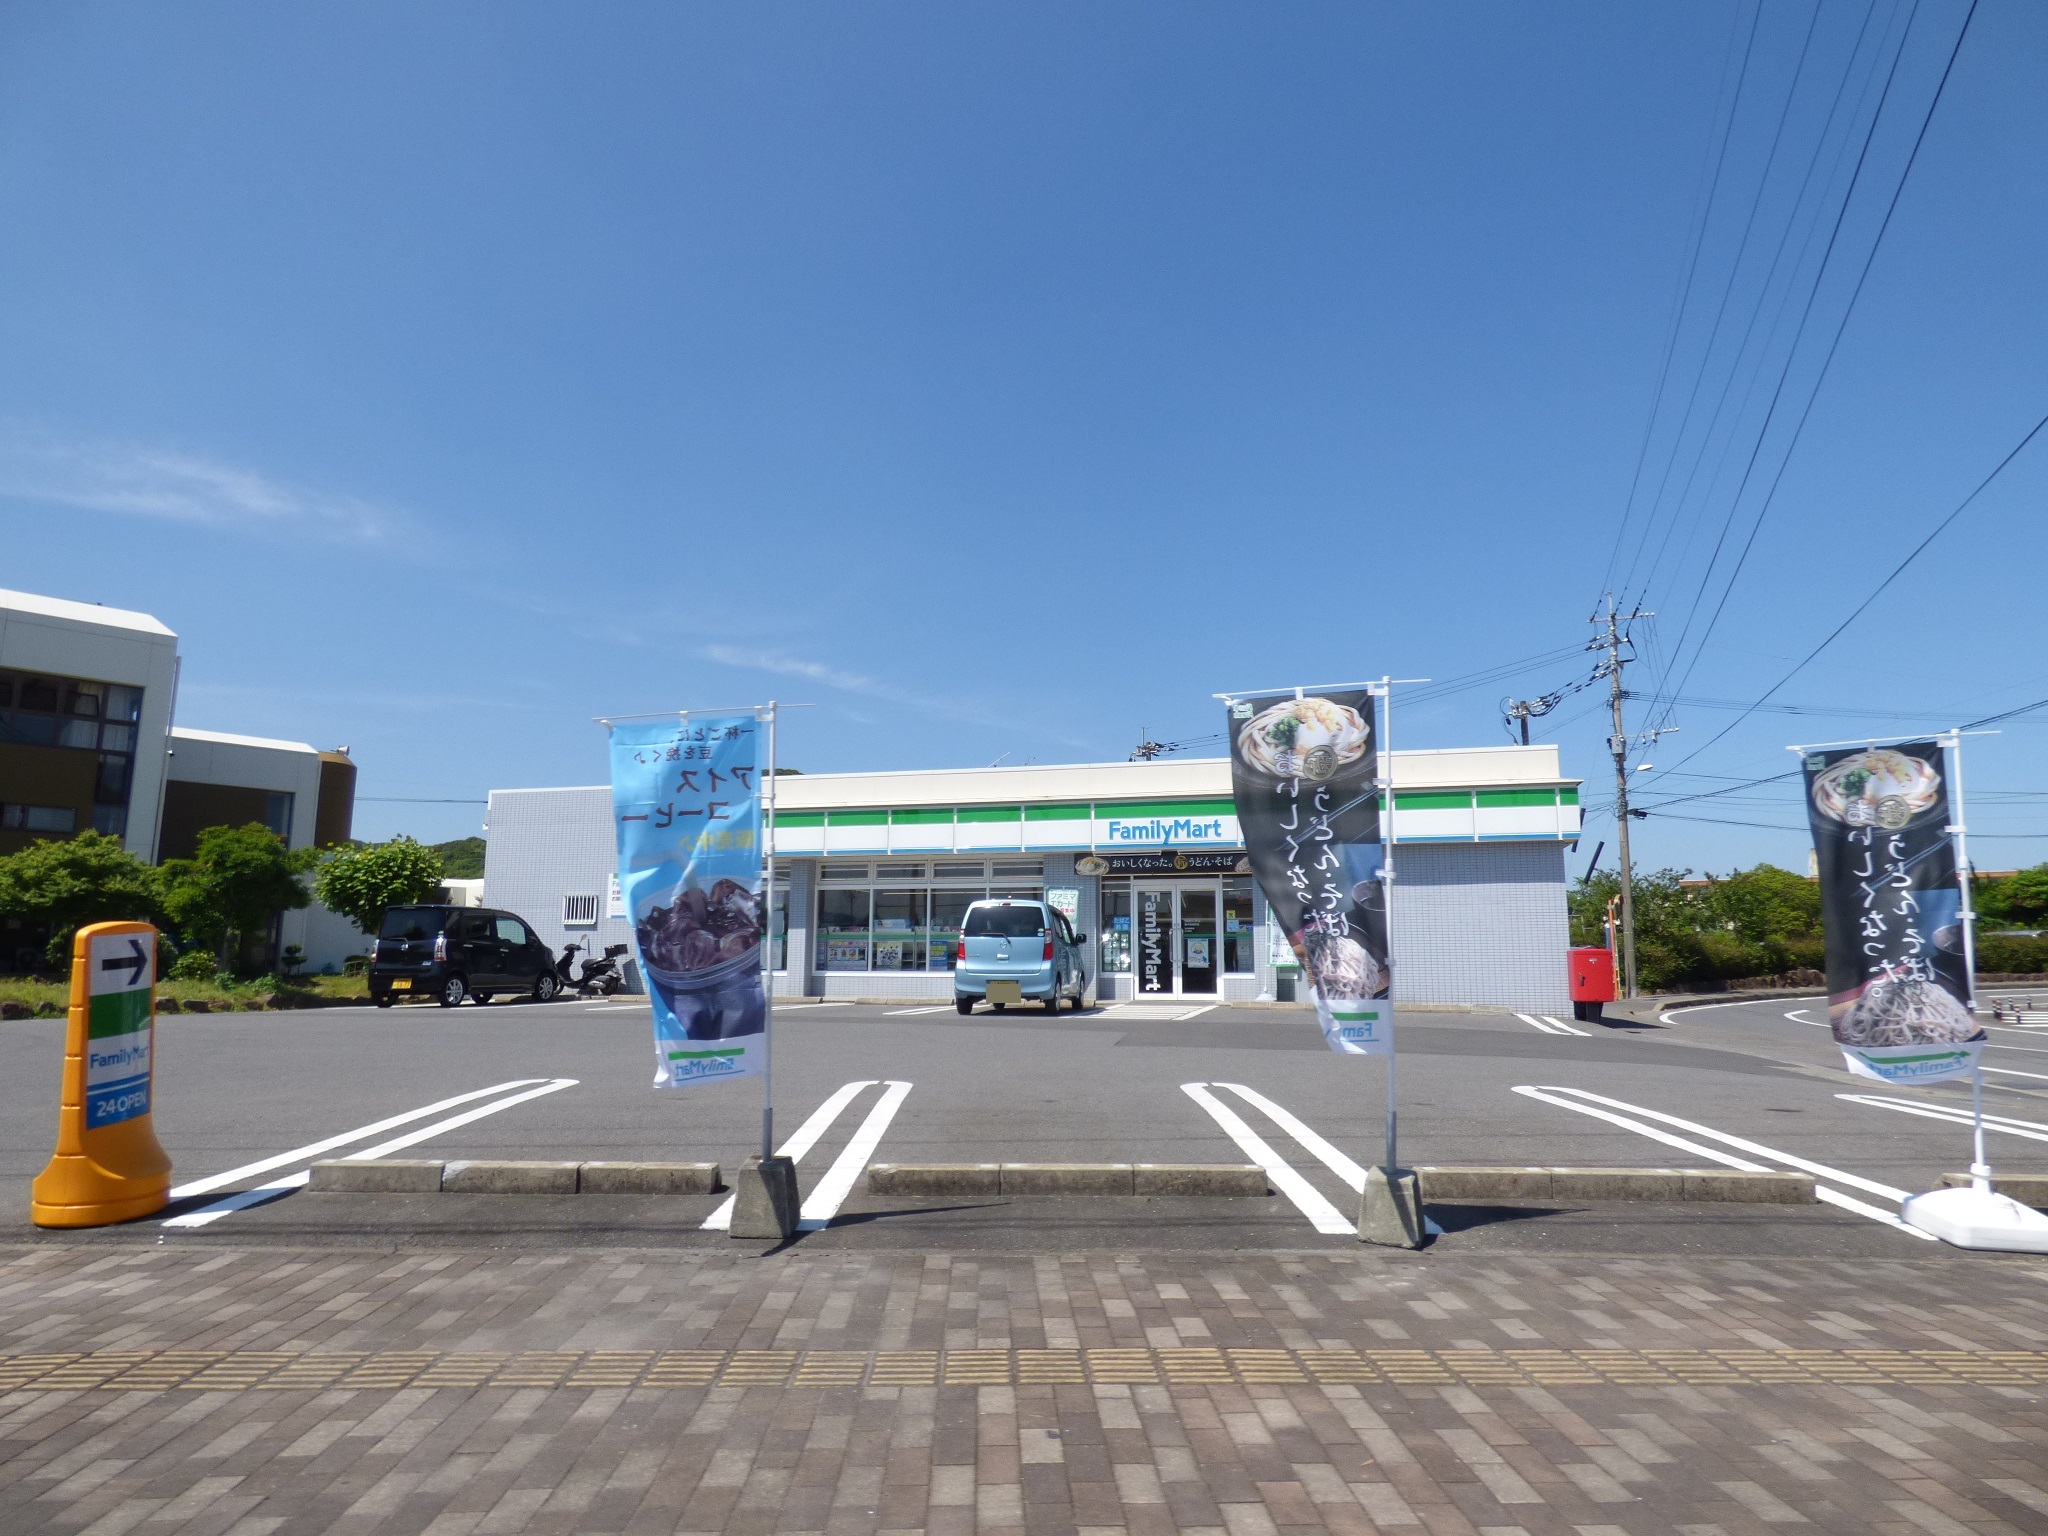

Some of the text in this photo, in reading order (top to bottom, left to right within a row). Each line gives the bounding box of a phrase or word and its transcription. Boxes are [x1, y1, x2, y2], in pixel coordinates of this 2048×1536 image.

[1108, 818, 1222, 845] FamilyMart
[1112, 856, 1173, 868] おいしくなった。
[1188, 855, 1233, 867] うどん・そば
[1050, 892, 1077, 900] ファミマ
[1141, 891, 1161, 991] FamilyMart
